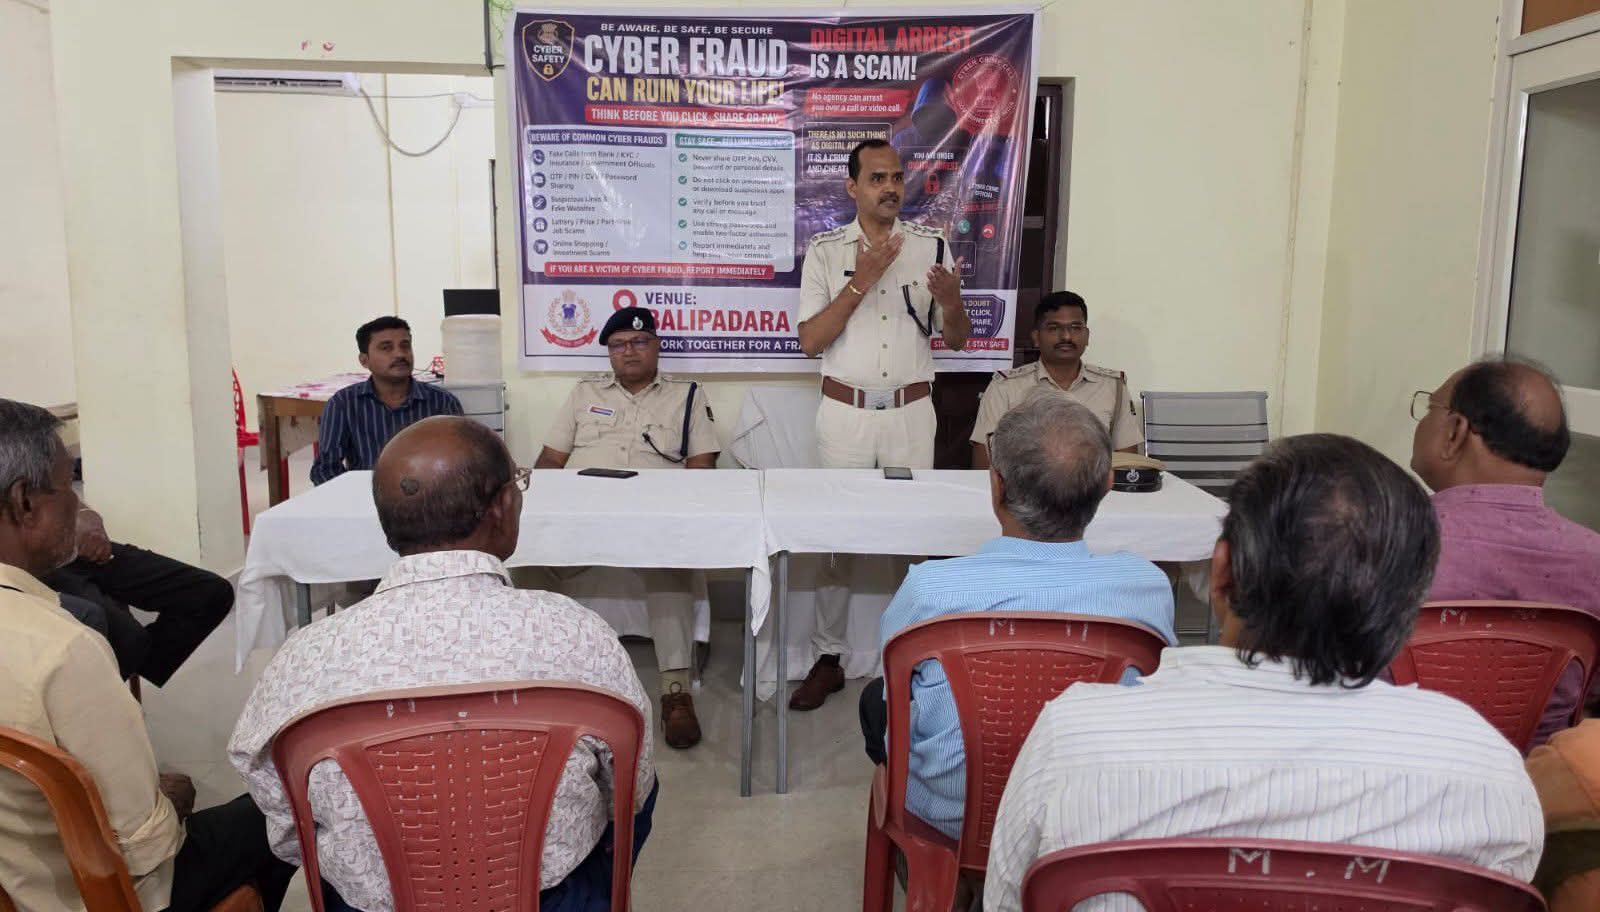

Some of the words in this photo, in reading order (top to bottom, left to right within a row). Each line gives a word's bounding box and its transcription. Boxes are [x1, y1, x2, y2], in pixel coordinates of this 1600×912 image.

[601, 23, 614, 31] BE
[618, 23, 660, 33] AWARE,
[664, 25, 677, 33] BE
[681, 25, 711, 34] SAFE,
[715, 26, 727, 34] BE
[731, 27, 773, 35] SECURE
[811, 27, 888, 52] DIGITAL
[896, 27, 973, 53] ARREST
[533, 45, 564, 54] CYBER
[584, 34, 680, 76] CYBER
[689, 37, 788, 77] FRAUD
[532, 54, 565, 63] SAFETY
[810, 53, 830, 79] IS
[834, 54, 849, 79] A
[854, 55, 917, 81] SCAM!
[587, 76, 627, 102] CAN
[634, 78, 679, 103] RUIN
[684, 79, 735, 104] YOUR
[823, 94, 847, 102] agency
[592, 108, 620, 120] THINK
[622, 109, 658, 121] BEFORE
[661, 110, 679, 122] YOU
[714, 112, 744, 123] SHARE
[747, 113, 760, 123] OR
[532, 133, 560, 142] BEWARE
[561, 133, 570, 142] OF
[572, 134, 606, 142] COMMON
[608, 135, 632, 143] CYBER
[633, 135, 663, 144] FRAUDS
[808, 130, 830, 139] THERE
[837, 130, 846, 139] NO
[847, 130, 865, 139] SUCH
[867, 130, 887, 139] THING
[550, 264, 556, 273] IF
[558, 264, 573, 273] YOU
[574, 264, 588, 273] ARE
[590, 264, 595, 273] A
[596, 264, 620, 273] VICTIM
[621, 264, 631, 273] OF
[632, 265, 656, 273] CYBER
[687, 266, 714, 275] REPORT
[719, 267, 767, 276] IMMEDIATELY
[645, 292, 697, 305] VENUE:
[651, 308, 790, 332] BALIPADARA
[660, 340, 684, 349] ORK
[686, 340, 746, 350] TOGETHER
[748, 340, 770, 350] FOR
[773, 341, 782, 350] A
